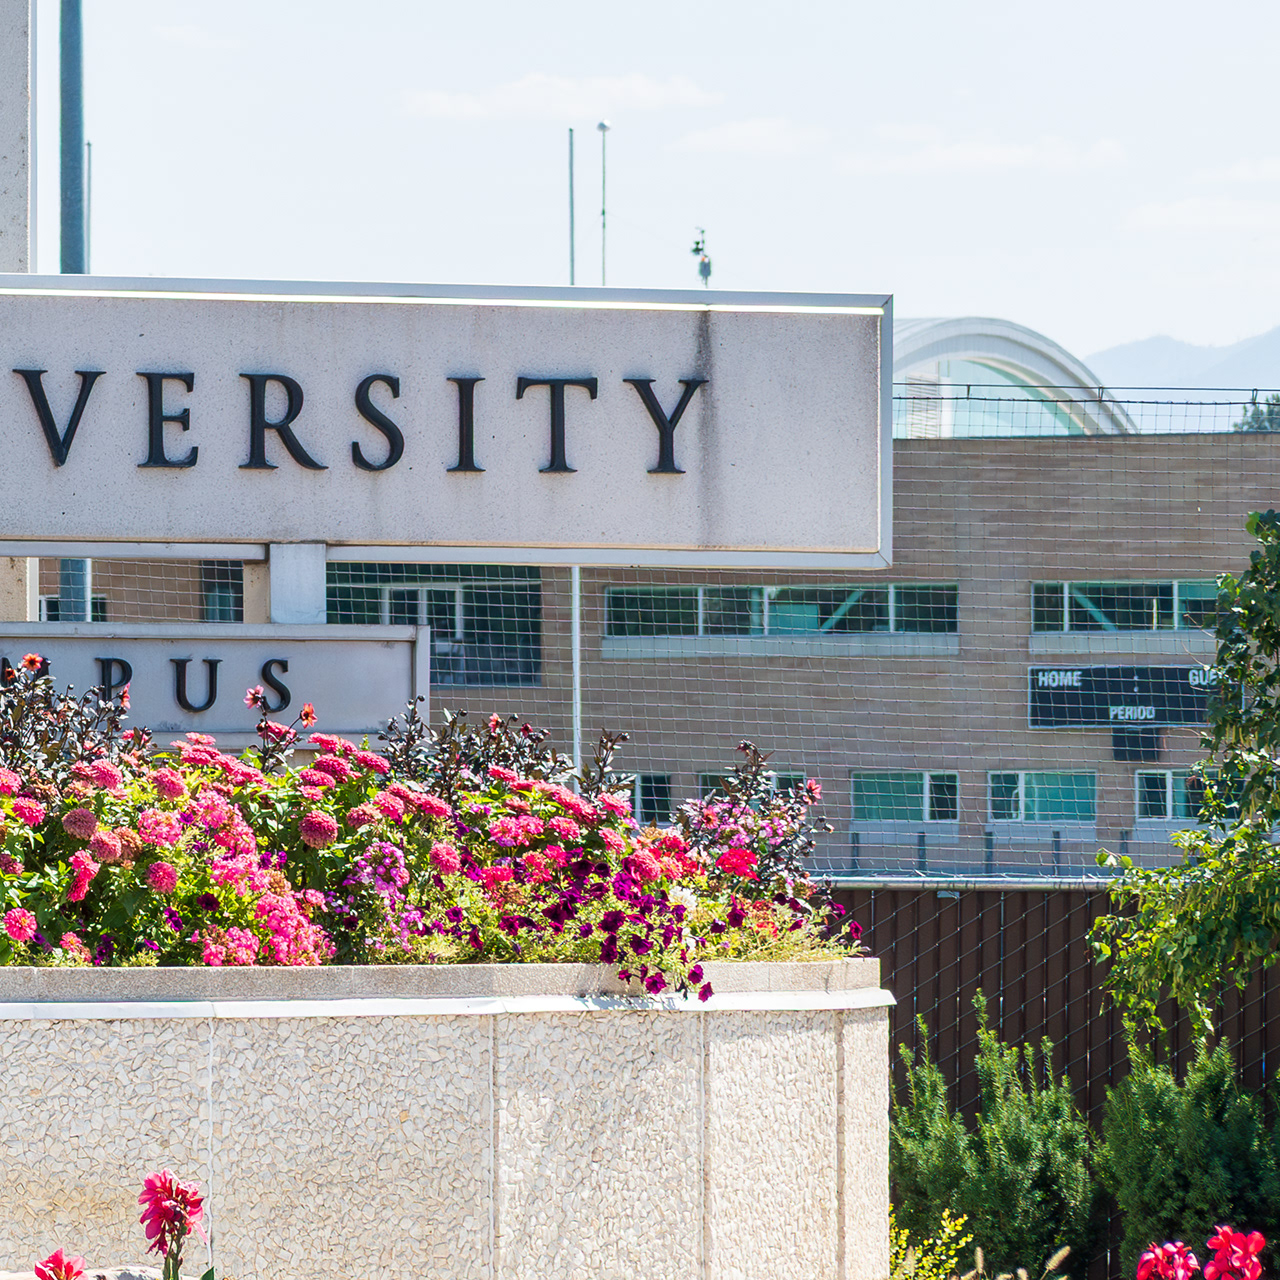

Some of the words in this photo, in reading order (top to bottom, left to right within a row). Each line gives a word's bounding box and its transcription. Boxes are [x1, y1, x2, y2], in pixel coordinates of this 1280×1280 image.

[1038, 671, 1083, 688] HOME
[1188, 669, 1231, 687] GUE
[1109, 706, 1156, 720] PERIOD
